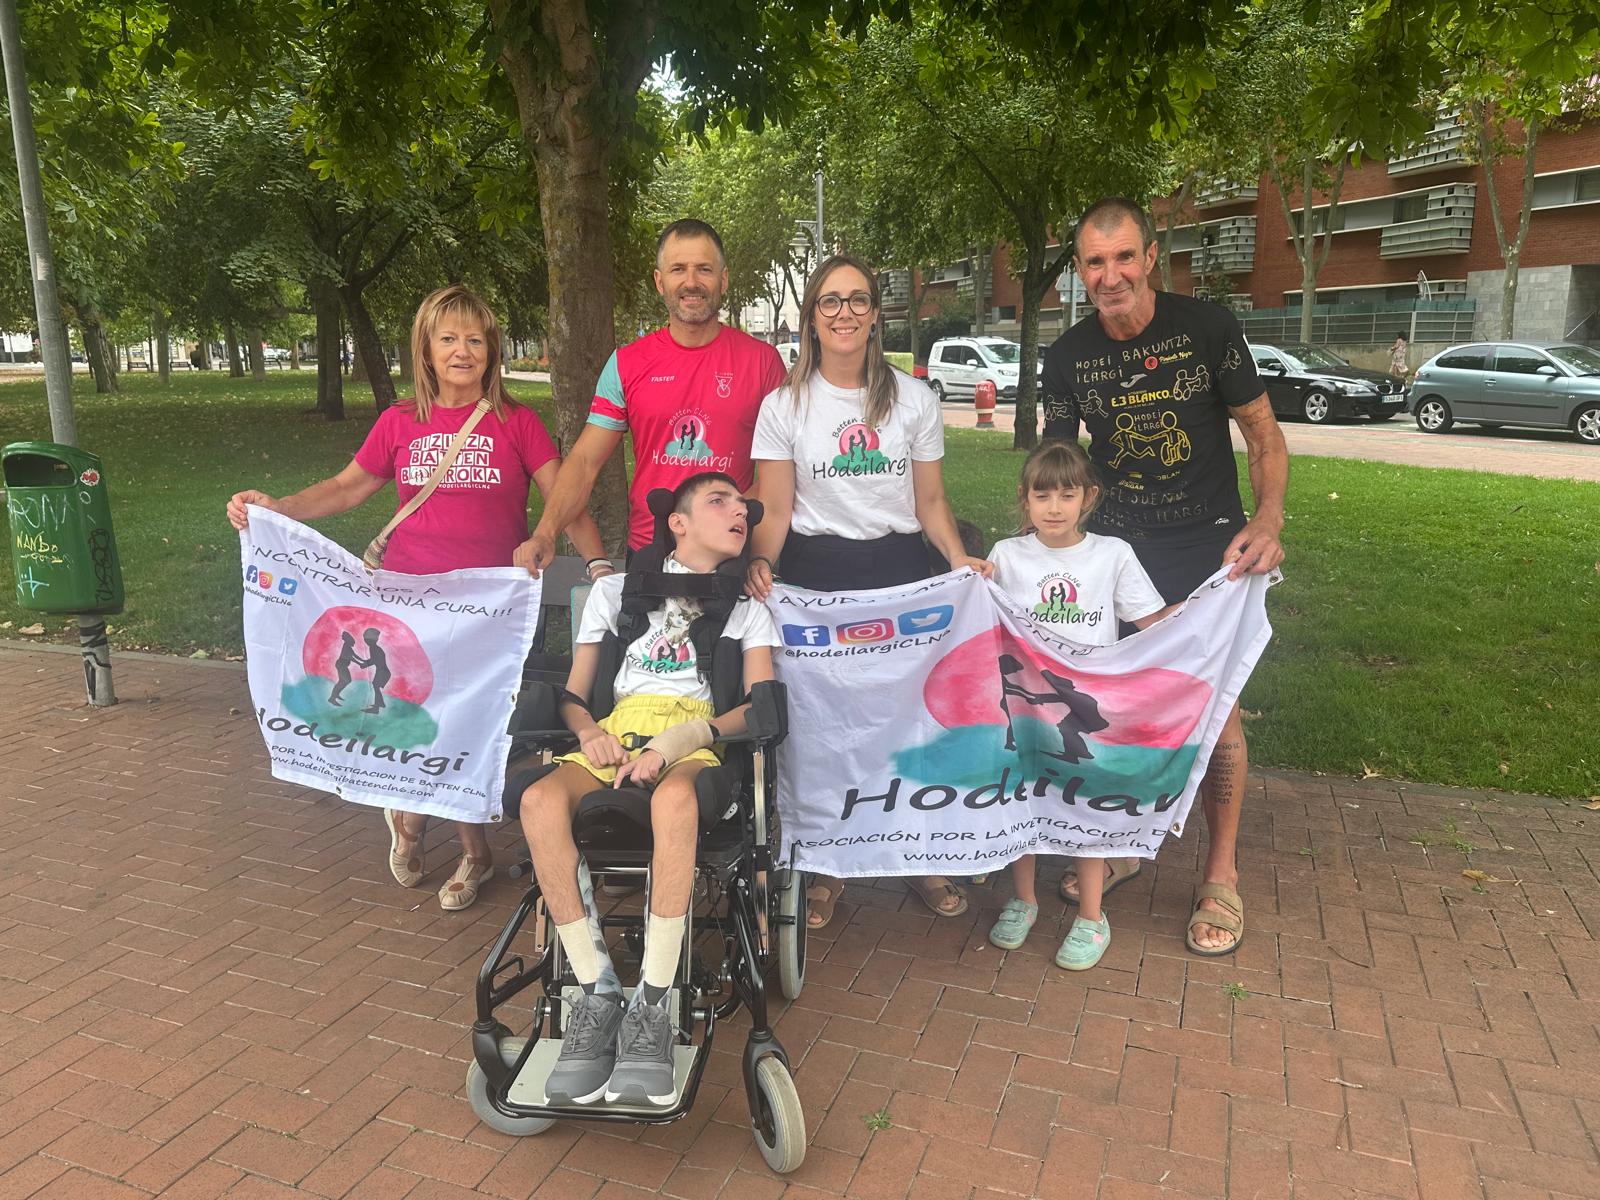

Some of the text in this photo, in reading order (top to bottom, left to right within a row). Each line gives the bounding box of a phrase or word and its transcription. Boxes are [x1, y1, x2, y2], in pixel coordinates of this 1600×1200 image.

[1122, 333, 1192, 362] BAKUNTZA
[1128, 389, 1170, 405] BLANCO
[832, 418, 859, 439] Batten
[651, 449, 735, 473] Hodeilargi
[812, 450, 910, 480] Hodeilarg
[380, 594, 426, 609] UNA
[434, 602, 513, 618] CURA!!!
[1025, 605, 1104, 627] odeilargi
[271, 745, 296, 756] POR
[299, 752, 313, 760] LA
[400, 776, 416, 784] DE
[419, 779, 461, 793] BATTEN
[792, 830, 921, 849] ASOCIACIÓN
[930, 832, 976, 842] POR
[985, 829, 1008, 840] LA
